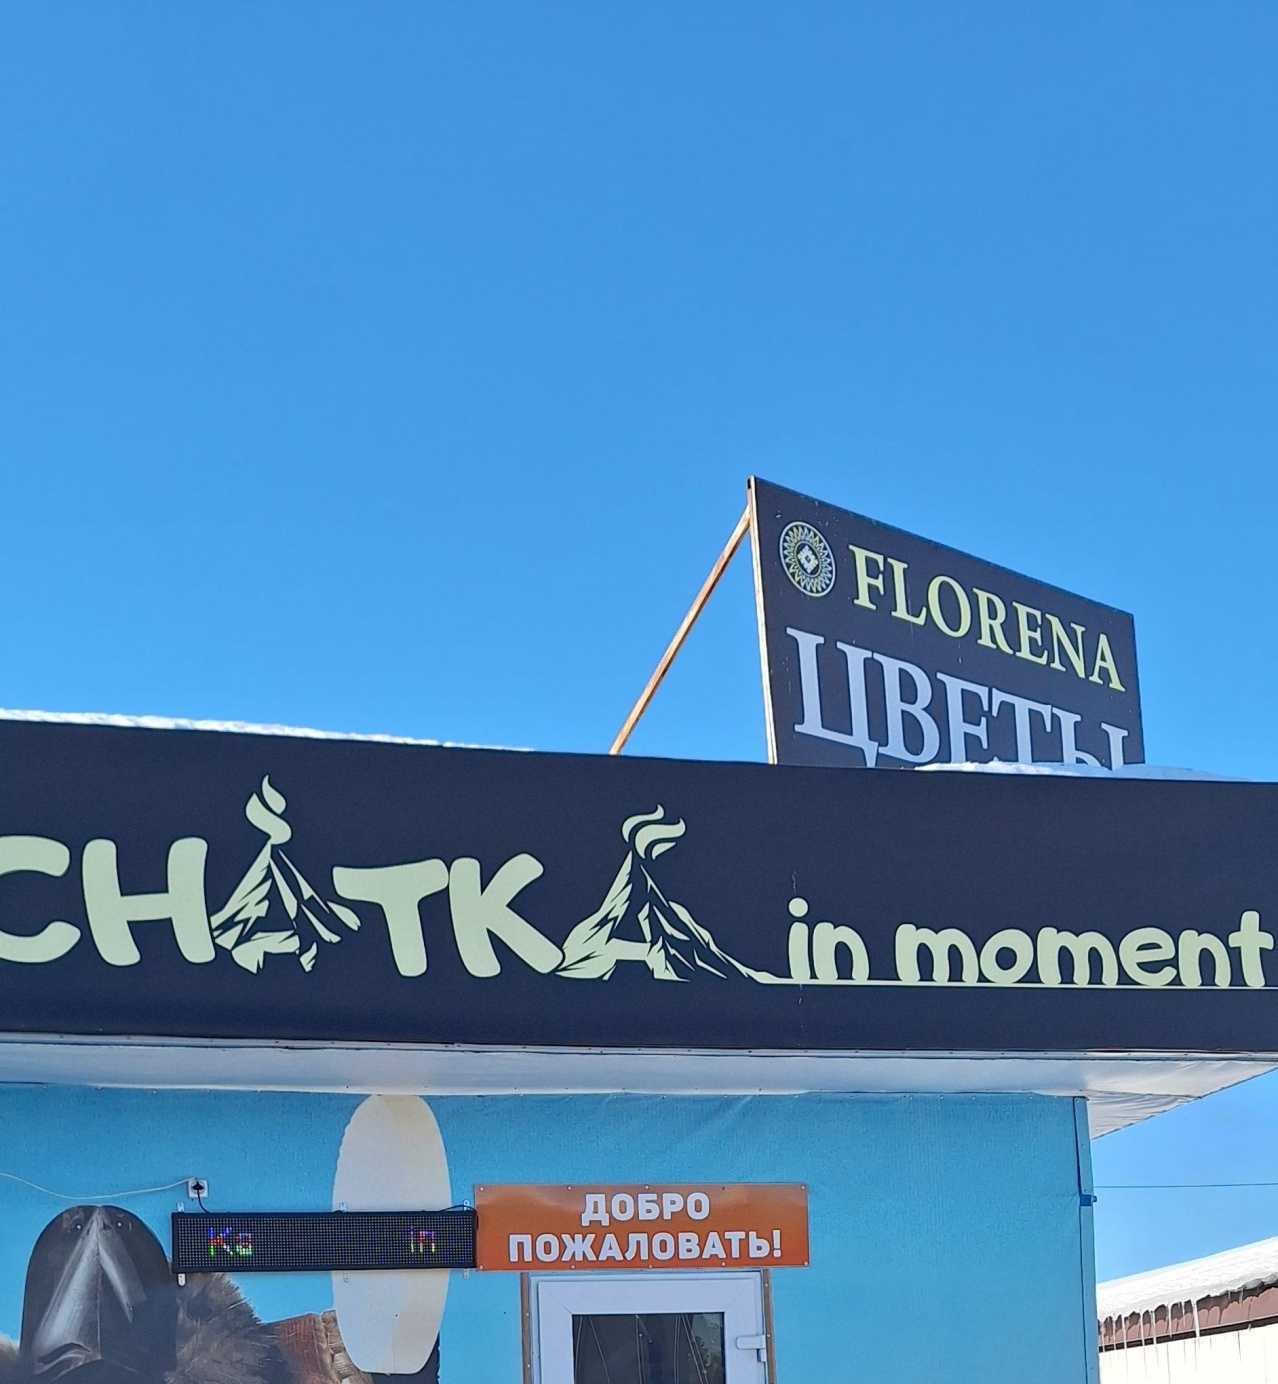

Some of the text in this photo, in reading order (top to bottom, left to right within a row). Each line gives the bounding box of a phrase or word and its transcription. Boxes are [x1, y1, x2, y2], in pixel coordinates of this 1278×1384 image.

[848, 544, 1126, 692] FLORENA
[786, 626, 1129, 771] ЦВЕТЫ
[788, 897, 870, 983] in
[895, 910, 1274, 988] moment
[508, 1229, 783, 1263] ПОЖАЛОВАТЬ!
[580, 1192, 711, 1227] ДОБРО
